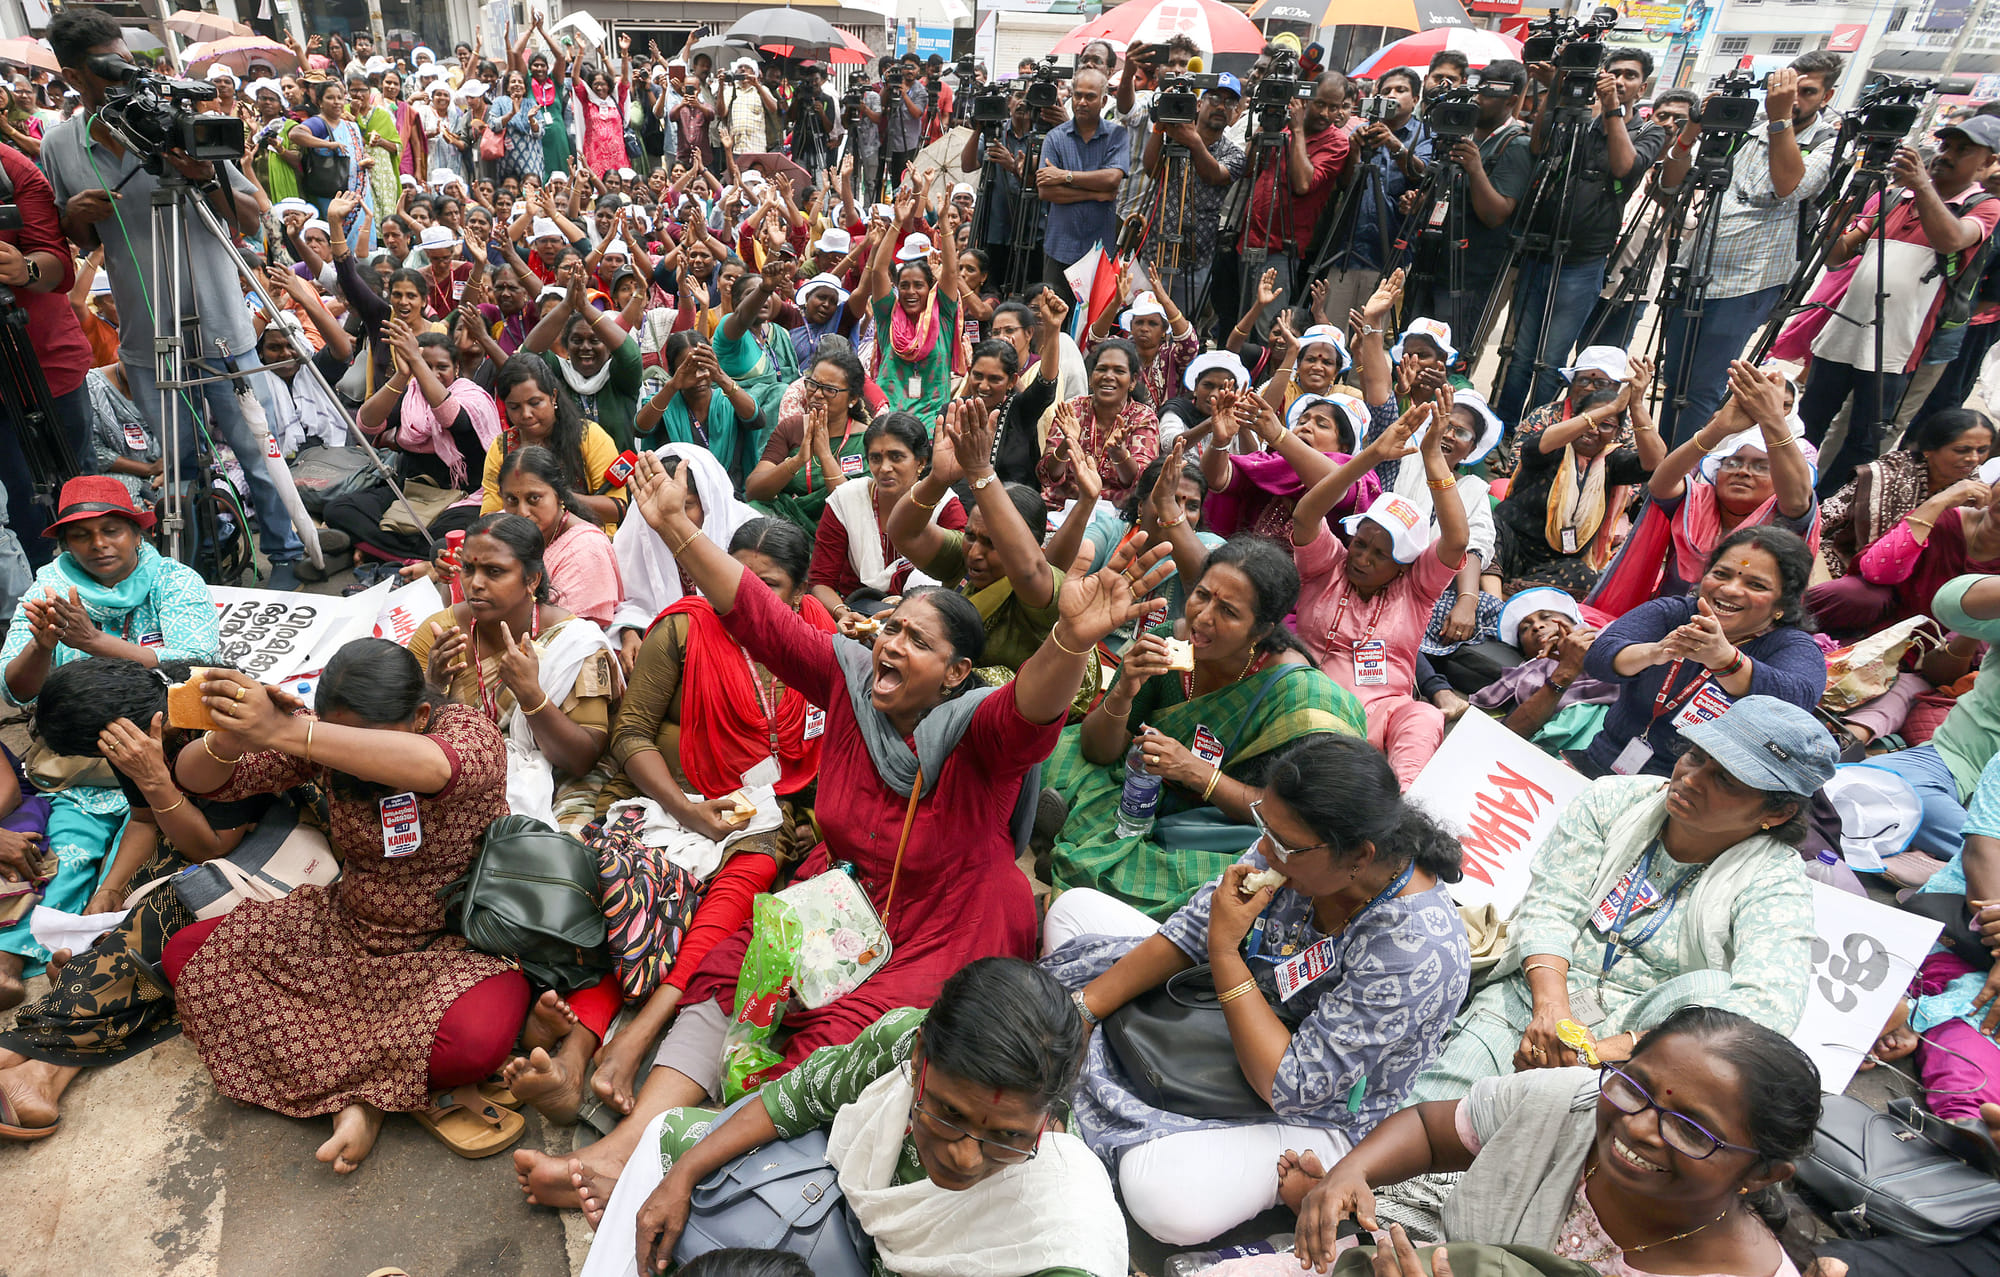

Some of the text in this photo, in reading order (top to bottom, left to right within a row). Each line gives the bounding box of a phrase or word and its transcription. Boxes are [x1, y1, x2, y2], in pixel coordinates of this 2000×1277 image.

[1358, 668, 1384, 677] KAHWA
[1682, 710, 1704, 725] KAH
[1769, 744, 1788, 758] Sports
[402, 823, 409, 831] 17
[1456, 760, 1555, 888] KAHWA
[387, 832, 418, 847] KAHWA
[1647, 911, 1666, 931] HEALTH
[1286, 960, 1300, 992] KAHWA
